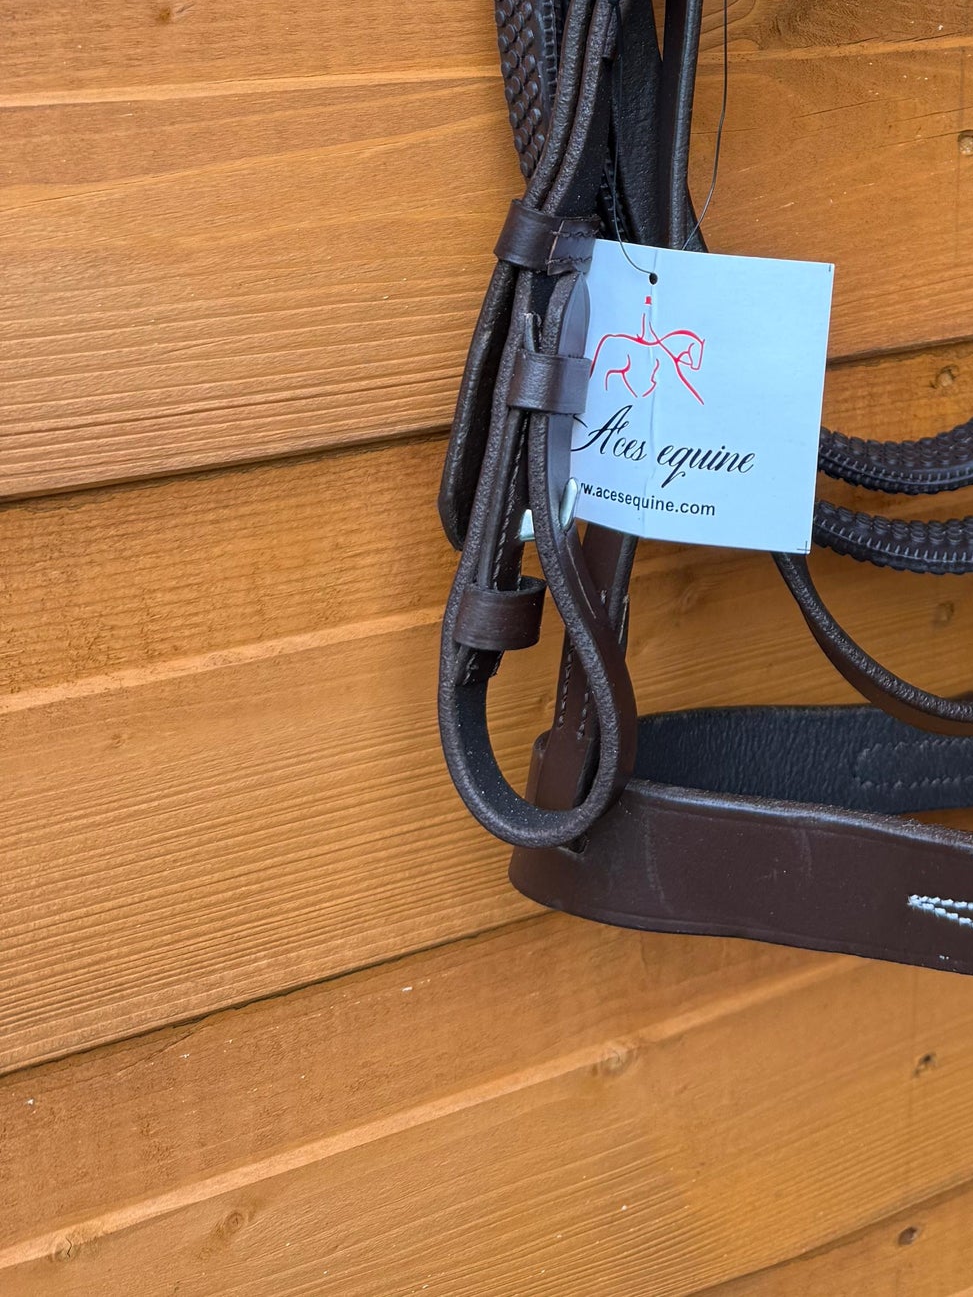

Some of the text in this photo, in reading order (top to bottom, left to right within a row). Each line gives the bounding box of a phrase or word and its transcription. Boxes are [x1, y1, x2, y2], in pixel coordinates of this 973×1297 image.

[571, 404, 756, 489] Aces equine
[580, 482, 716, 516] w.acesequine.com
